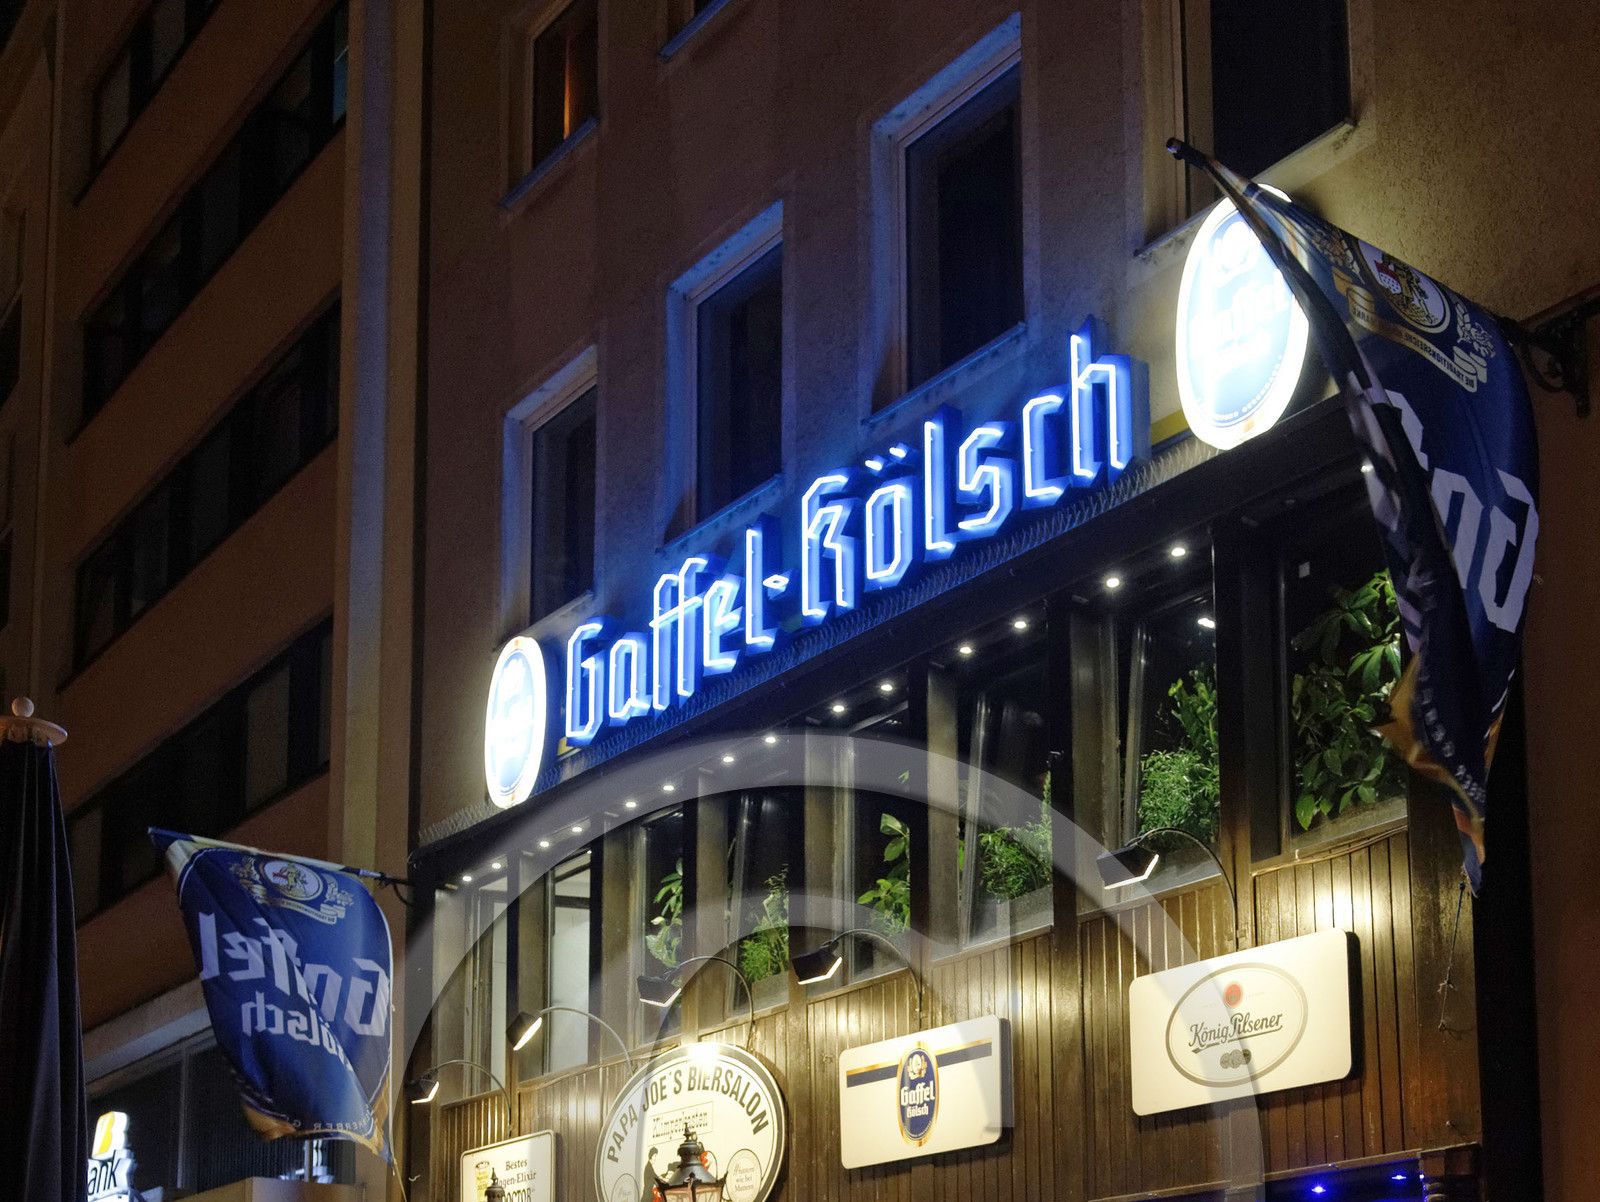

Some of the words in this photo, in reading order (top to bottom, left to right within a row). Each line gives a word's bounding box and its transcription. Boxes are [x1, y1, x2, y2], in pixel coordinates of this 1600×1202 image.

[565, 322, 1132, 746] Gaffel-Kölsch
[1188, 1021, 1229, 1048] König
[1228, 1012, 1283, 1039] Pilsener
[900, 1081, 935, 1106] Gaffel
[606, 1103, 639, 1163] PAPA
[687, 1065, 769, 1135] BIERSALON
[87, 1149, 121, 1195] ank
[498, 1170, 537, 1189] agen-Elixir
[505, 1159, 528, 1171] Bestes
